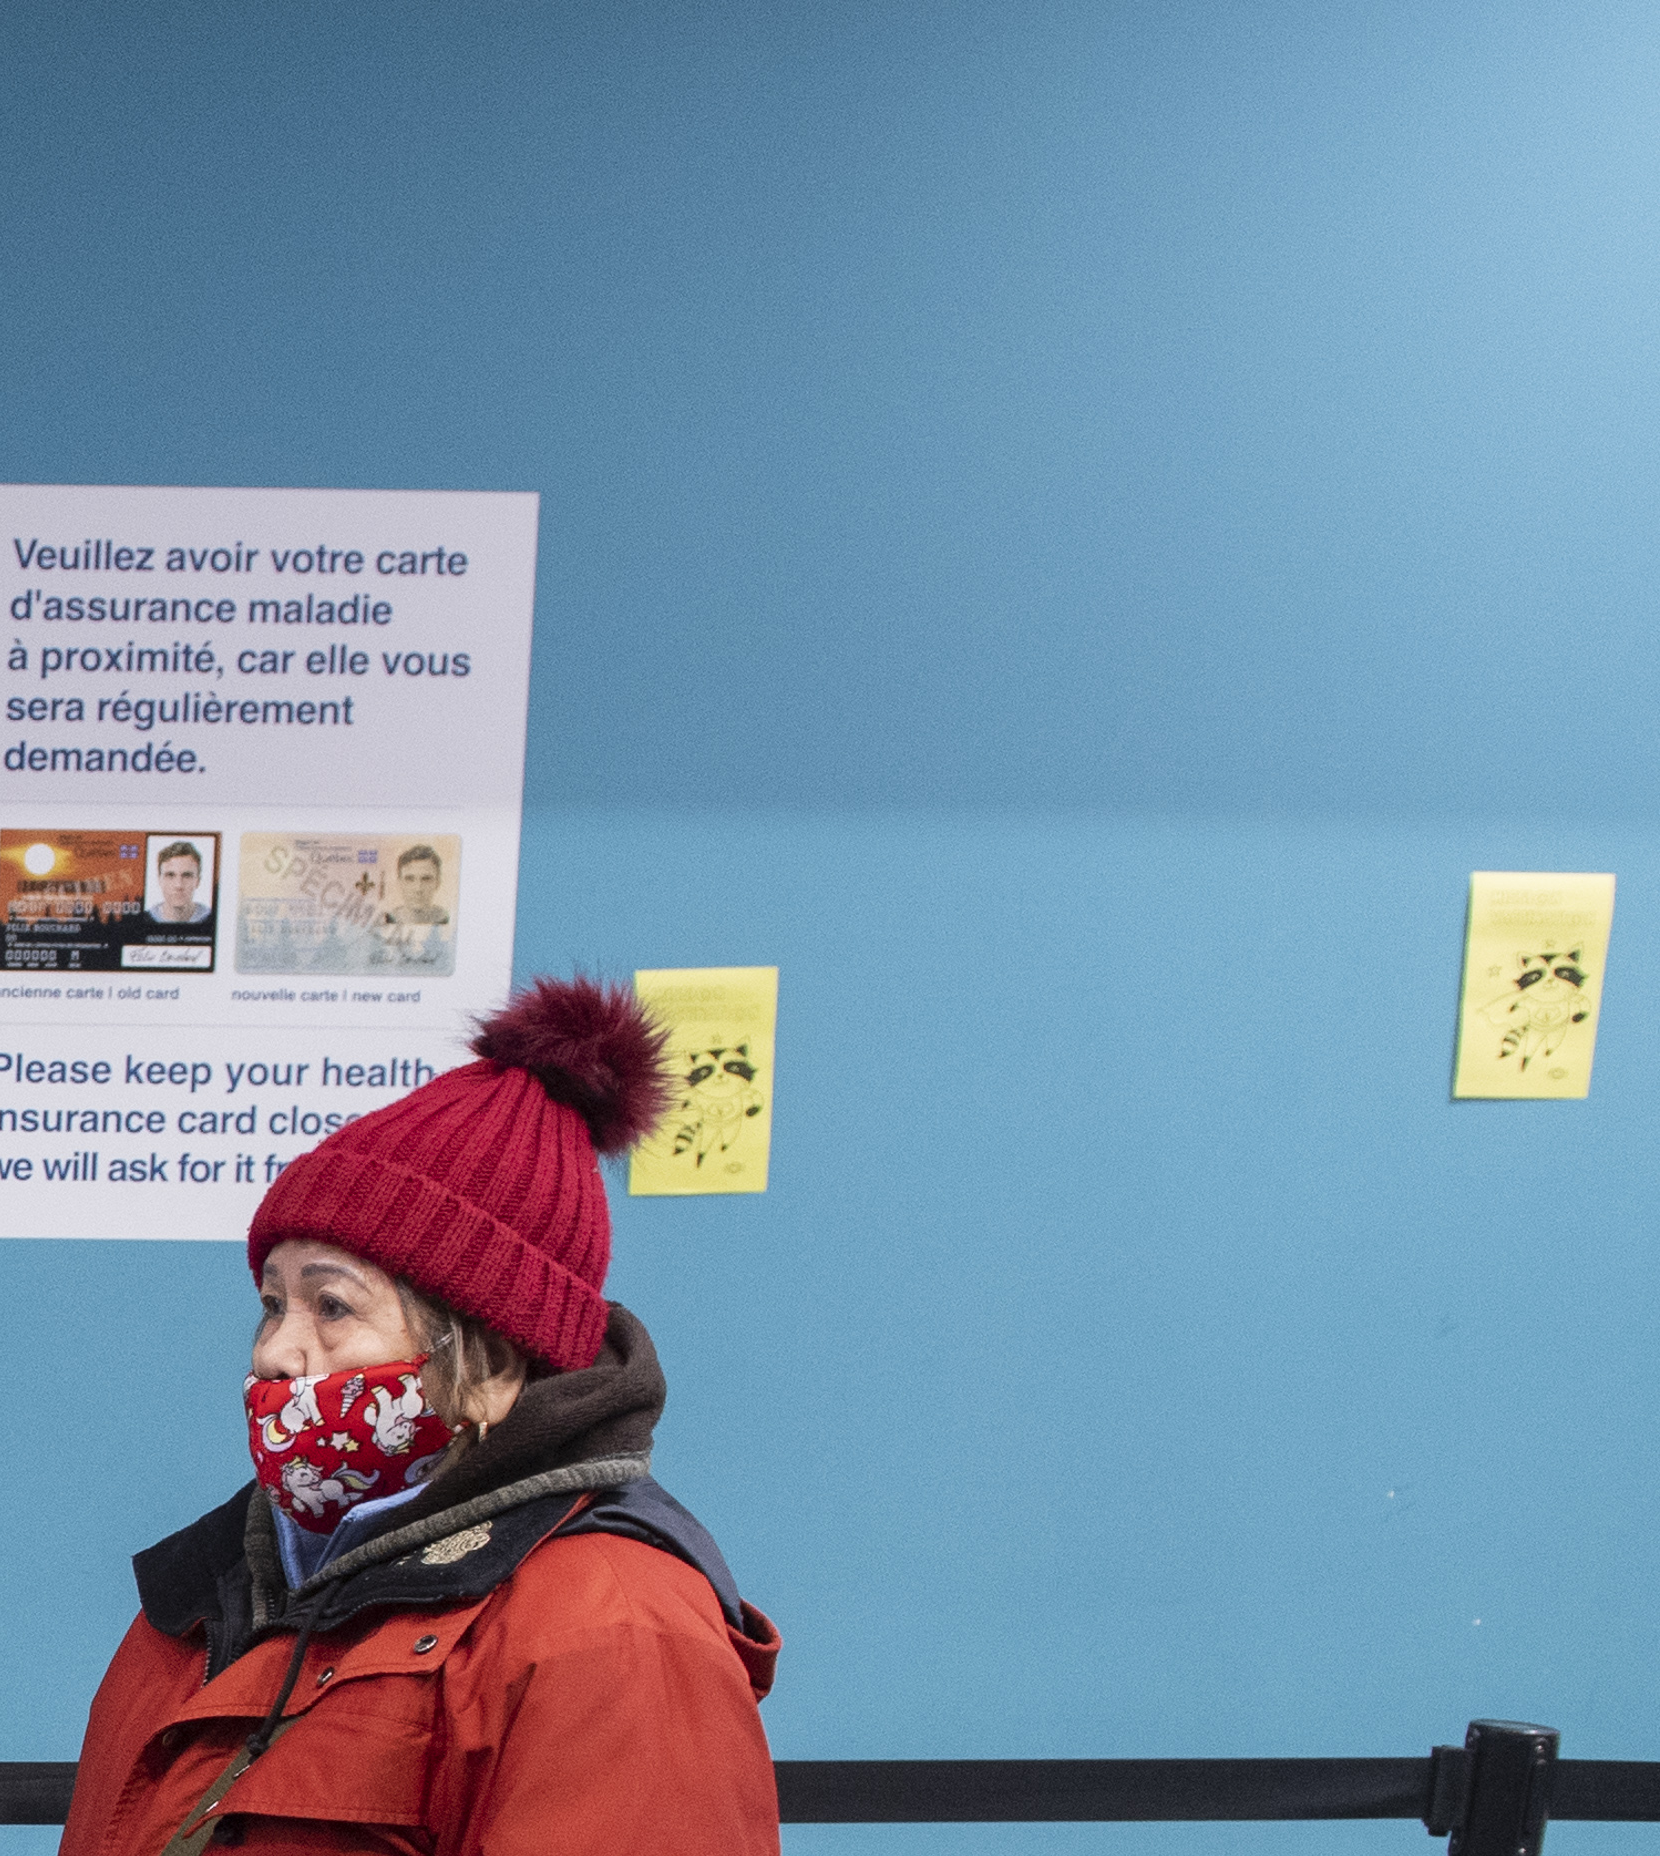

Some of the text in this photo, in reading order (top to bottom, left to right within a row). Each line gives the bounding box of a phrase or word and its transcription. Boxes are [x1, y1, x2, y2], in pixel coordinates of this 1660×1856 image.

[14, 538, 468, 575] Veuillez avoir votre carte
[10, 590, 392, 624] d'assurance maladie
[7, 639, 471, 678] à proximité, car elle vous
[6, 691, 354, 730] sera régulièrement
[4, 741, 206, 773] demandée.
[66, 987, 103, 998] carte
[118, 987, 141, 999] old
[146, 987, 180, 1000] card
[232, 988, 295, 1000] nouvelle
[301, 989, 338, 1001] carte
[352, 991, 382, 1001] new
[388, 990, 421, 1002] card
[125, 1054, 212, 1092] keep
[226, 1062, 309, 1093] your
[323, 1057, 434, 1086] health
[178, 1105, 257, 1135] card
[43, 1151, 98, 1181] will
[108, 1153, 167, 1182] ask
[179, 1153, 226, 1183] for
[235, 1154, 255, 1183] it
